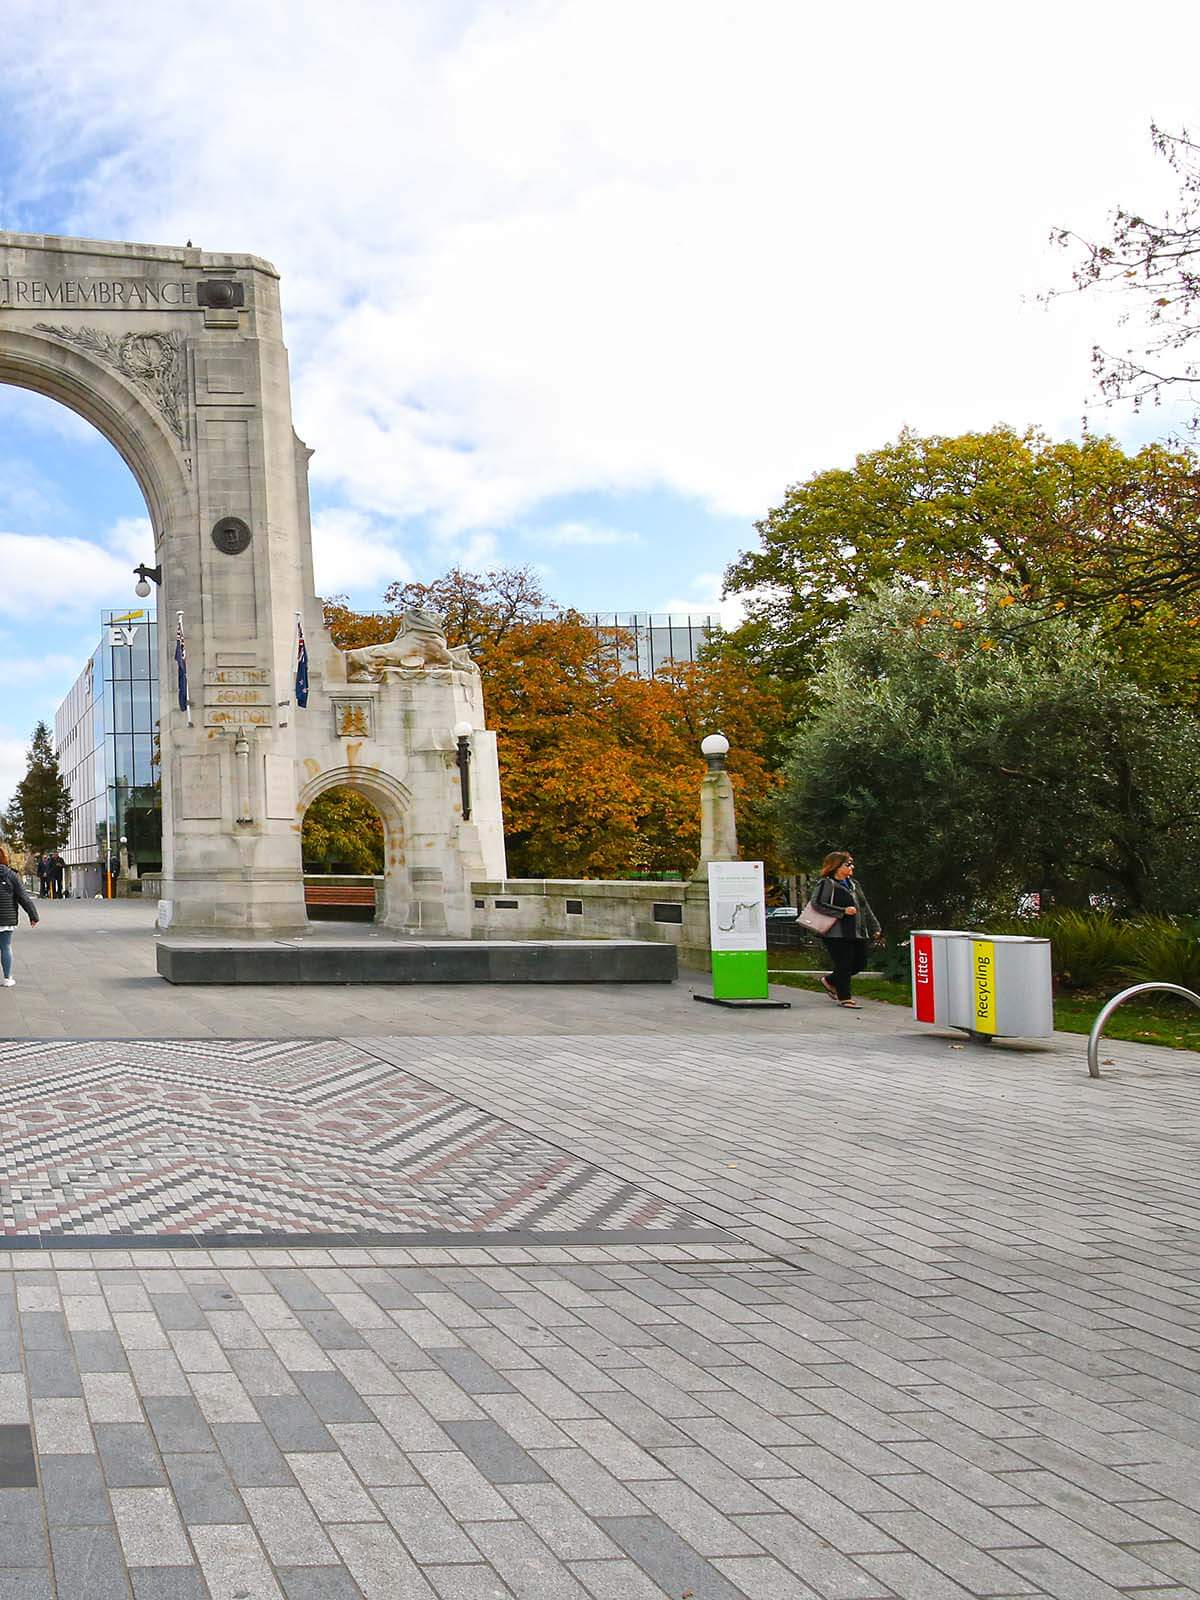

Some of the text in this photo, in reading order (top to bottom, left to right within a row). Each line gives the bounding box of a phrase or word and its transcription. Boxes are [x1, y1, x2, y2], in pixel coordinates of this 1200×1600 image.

[16, 281, 193, 305] REMEMBRANCE
[110, 626, 139, 646] EY
[208, 670, 267, 683] PALESTINE
[216, 690, 257, 703] EGYPT
[917, 950, 929, 984] Litter
[976, 956, 991, 1018] Recycling
